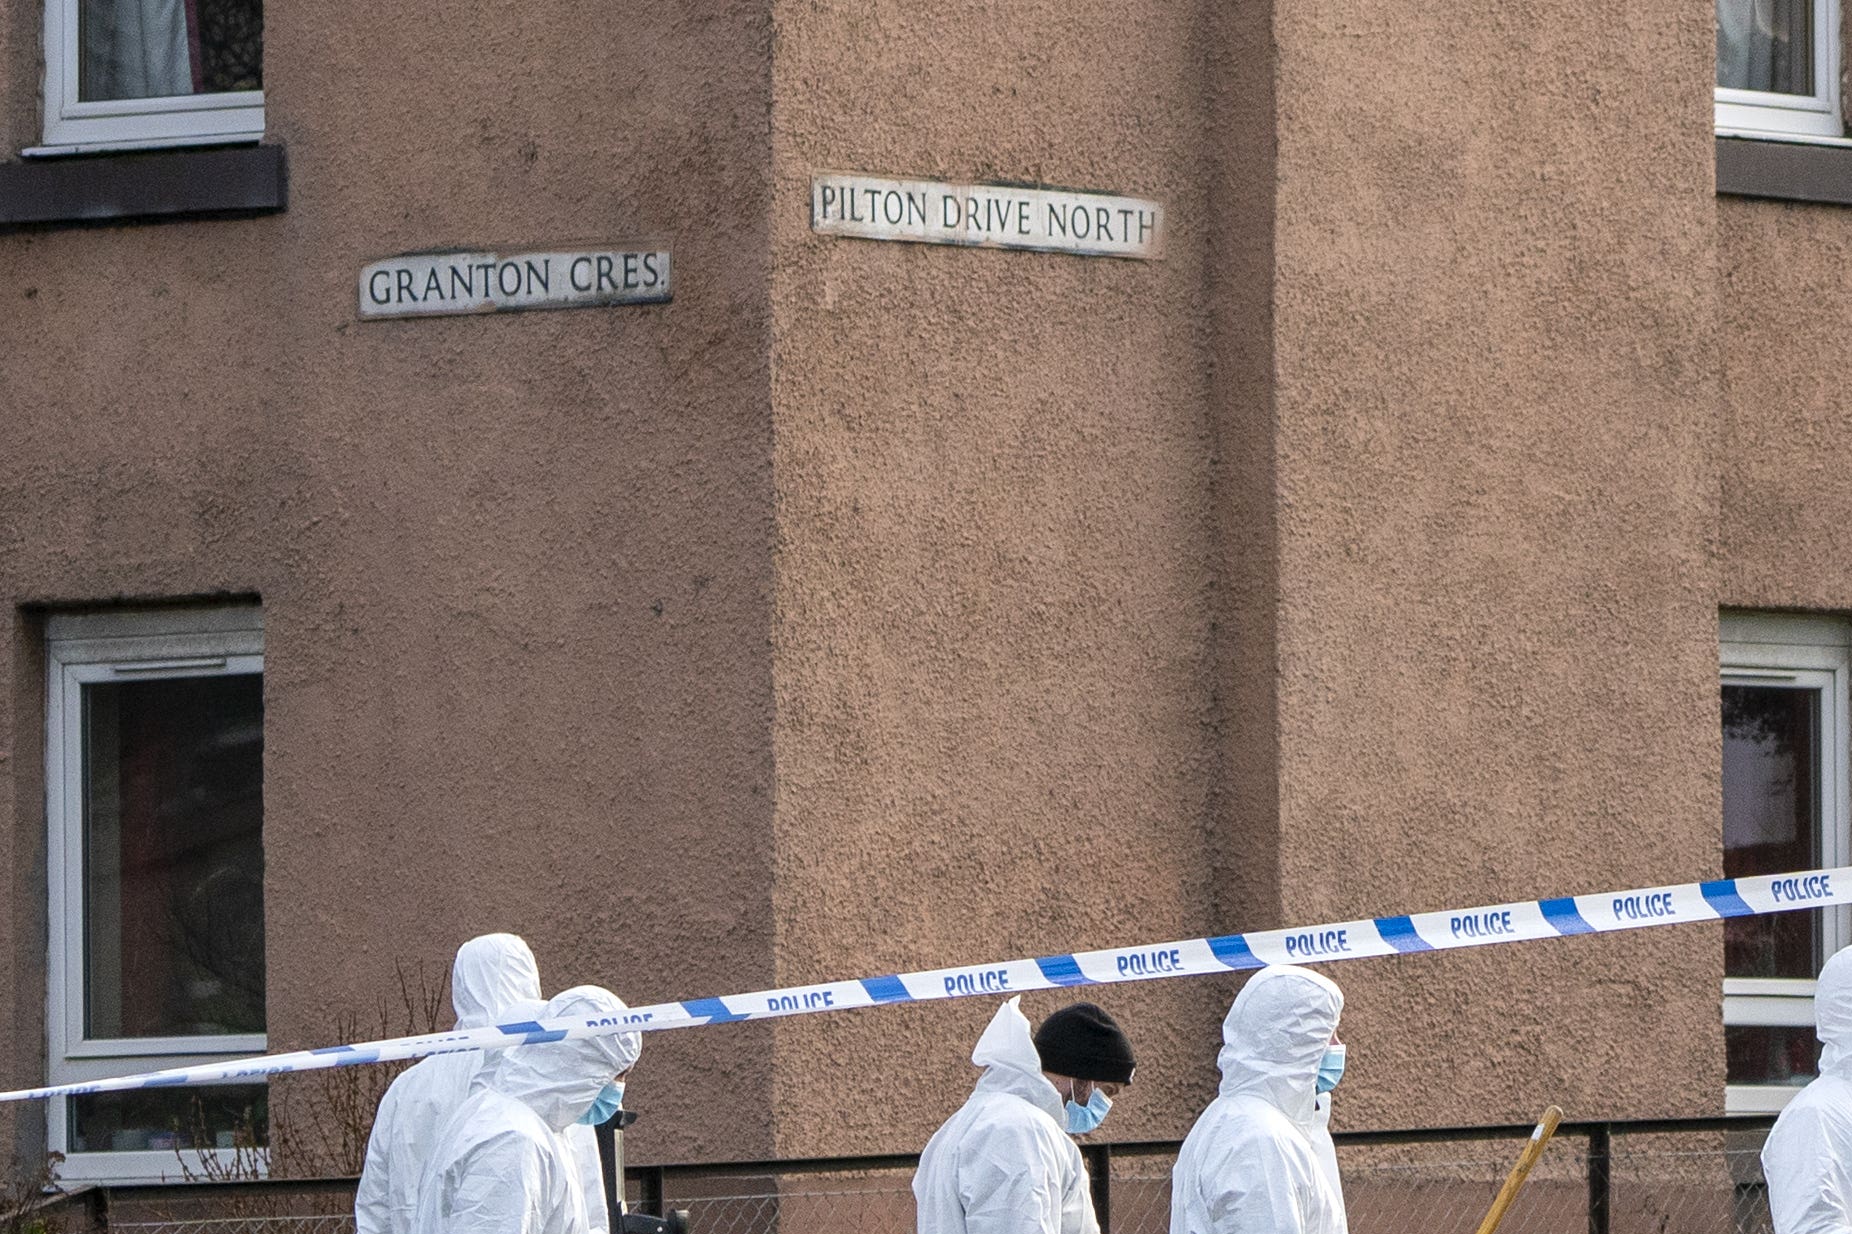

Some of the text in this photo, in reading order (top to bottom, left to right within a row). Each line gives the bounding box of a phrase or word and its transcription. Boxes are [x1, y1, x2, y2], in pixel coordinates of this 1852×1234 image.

[820, 186, 1155, 244] PILTON DRIVE NORTH
[369, 253, 665, 305] GRANTON CRES.
[944, 970, 1013, 996] POLICE
[1117, 949, 1185, 976] POLICE
[1285, 930, 1351, 957] POLICE
[1451, 911, 1515, 939] POLICE
[1612, 893, 1676, 920] POLICE
[1771, 875, 1834, 902] POLICE
